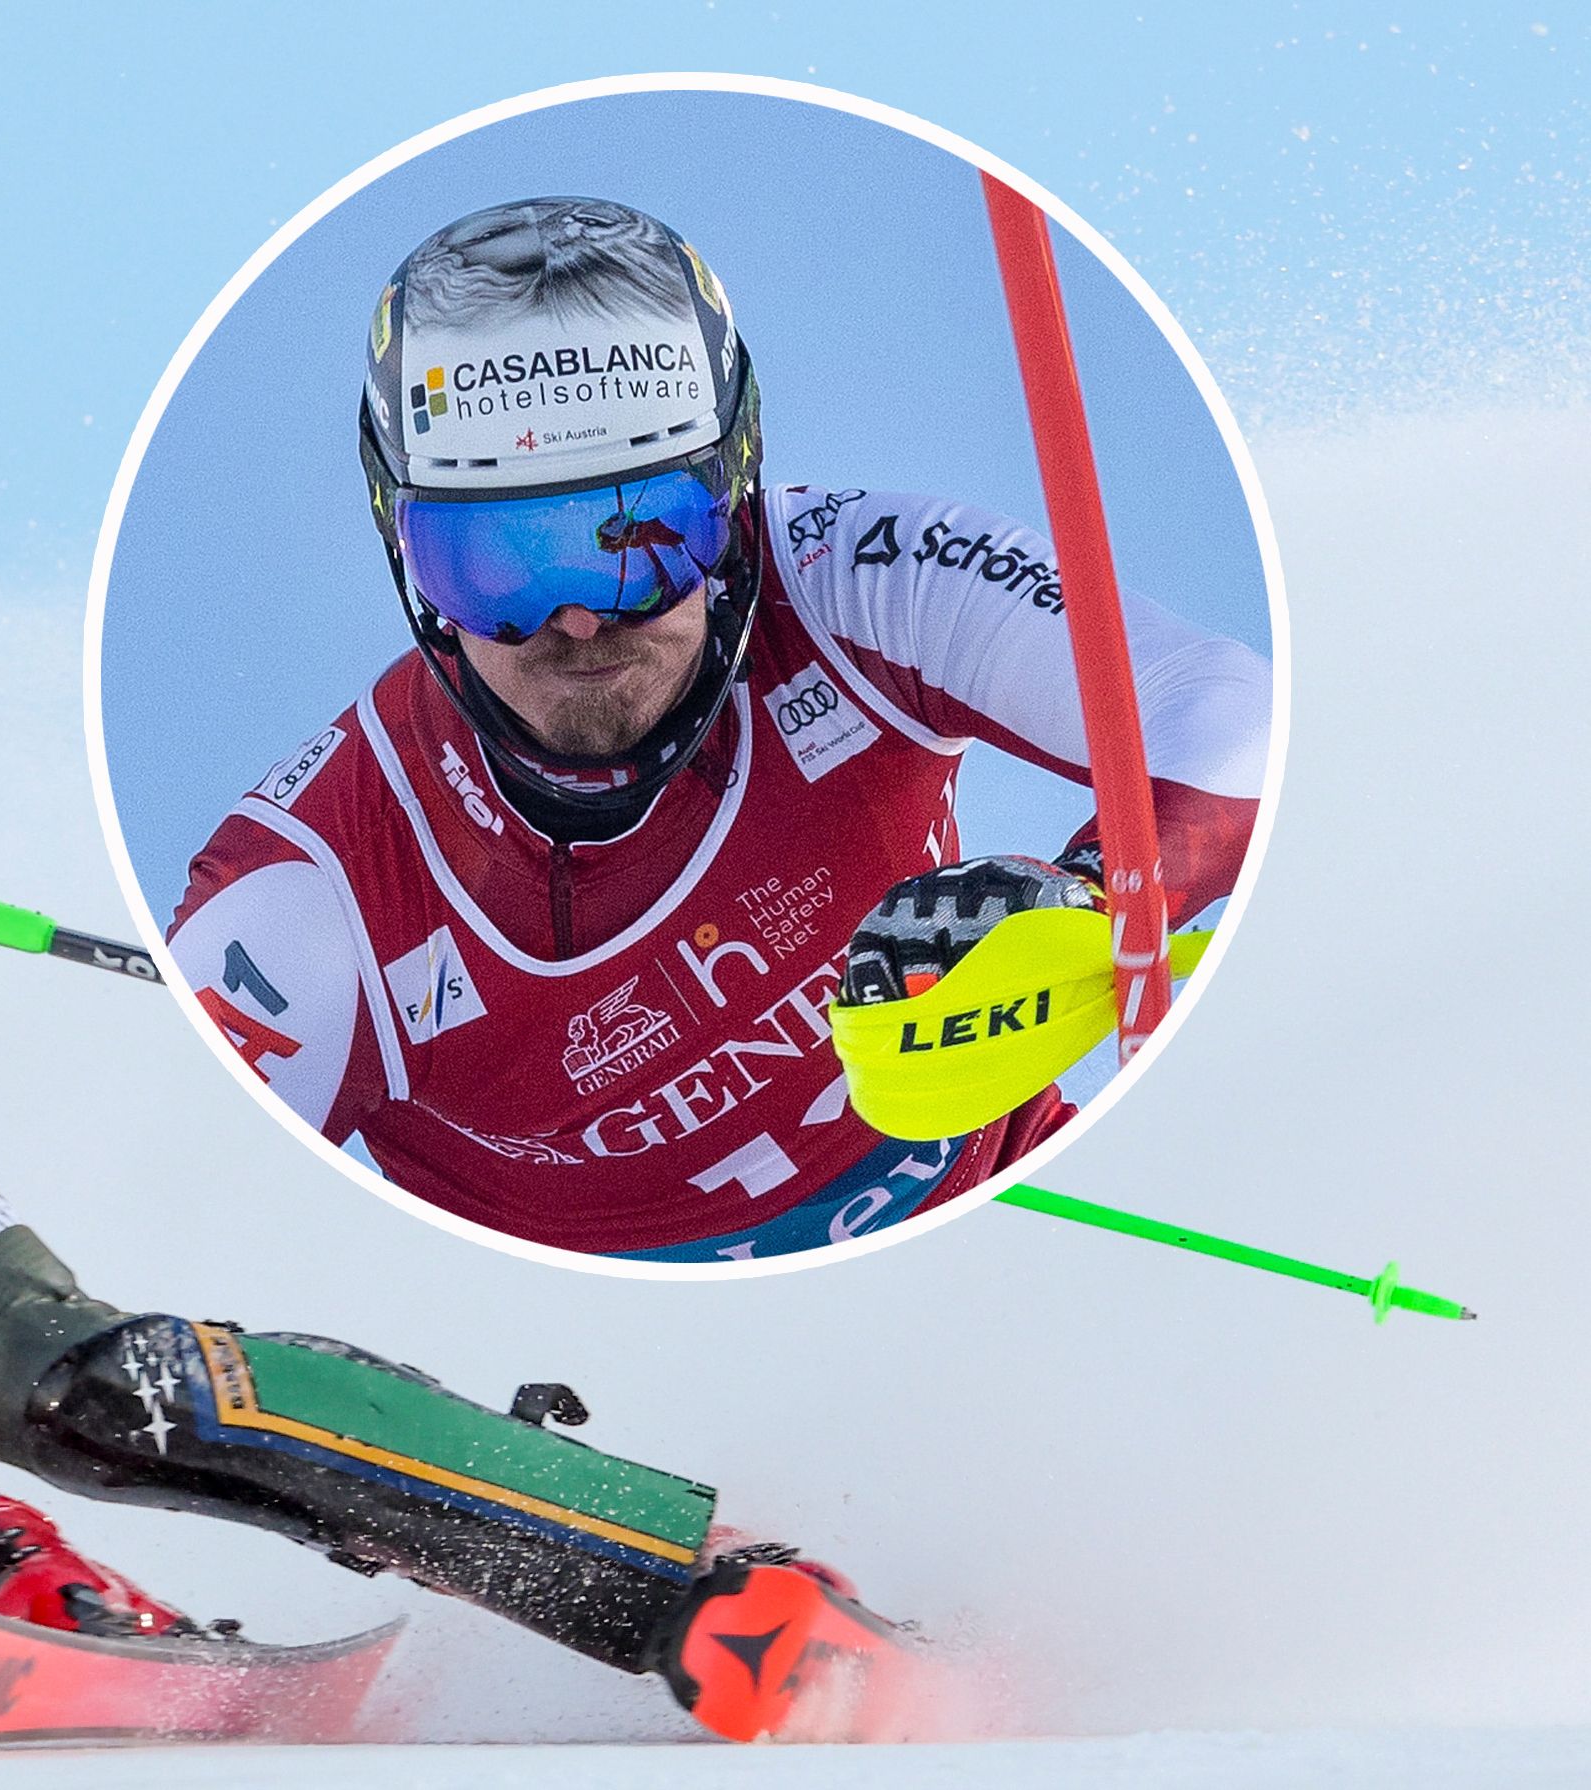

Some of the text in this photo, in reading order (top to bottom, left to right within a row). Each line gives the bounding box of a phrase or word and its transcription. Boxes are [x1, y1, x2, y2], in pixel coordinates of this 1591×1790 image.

[453, 343, 696, 392] CASABLANCA
[456, 376, 699, 420] hotelsoftware
[543, 427, 607, 444] Ski Austria
[735, 877, 782, 910] The
[749, 867, 831, 930] Human
[762, 885, 833, 945] Safety
[774, 922, 819, 960] Net
[899, 989, 1051, 1053] LEKI
[575, 1025, 682, 1097] GENERALI
